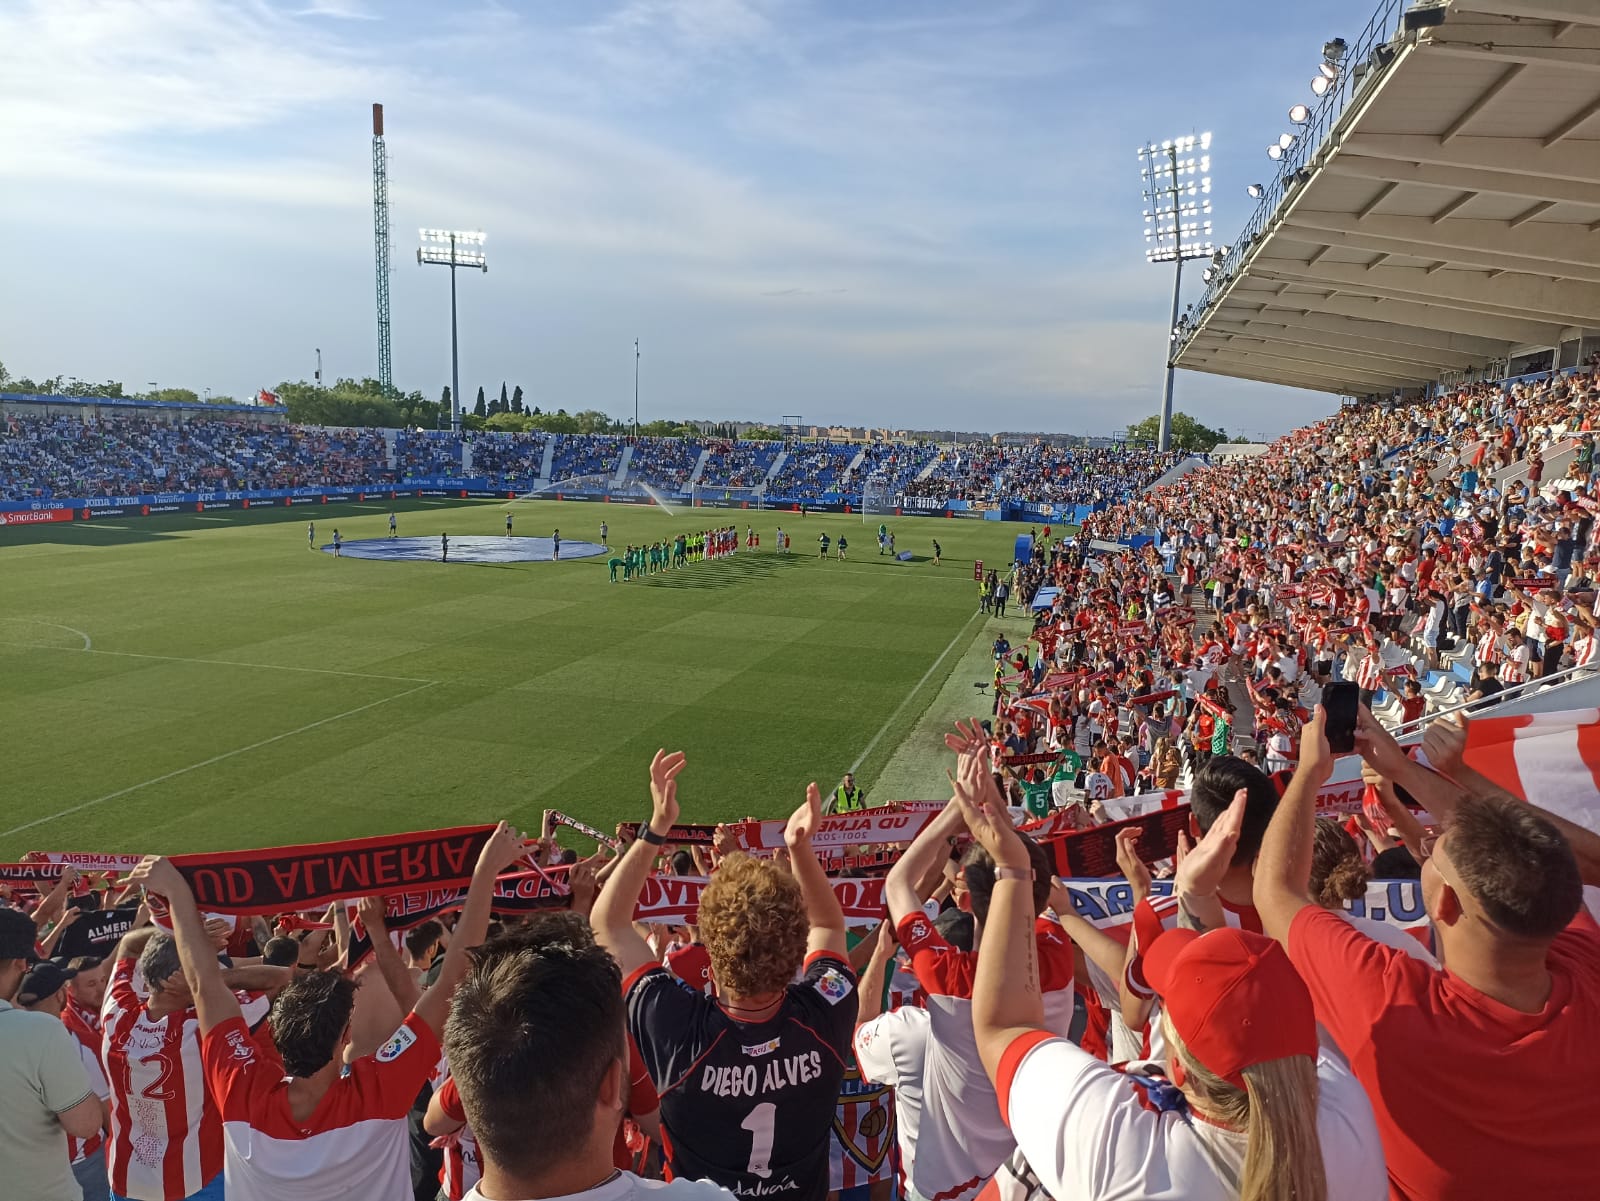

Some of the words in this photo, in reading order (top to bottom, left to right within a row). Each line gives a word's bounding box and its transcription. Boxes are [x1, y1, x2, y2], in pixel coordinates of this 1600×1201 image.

[198, 493, 215, 502] KFC
[226, 492, 242, 500] KFC
[8, 513, 53, 523] SmartBank
[1063, 760, 1073, 772] 16
[1095, 784, 1107, 800] 21
[1036, 793, 1045, 808] 5
[88, 921, 132, 939] ALMERI
[700, 1065, 757, 1097] DIEGO
[762, 1051, 822, 1093] ALVES
[741, 1102, 776, 1178] 1
